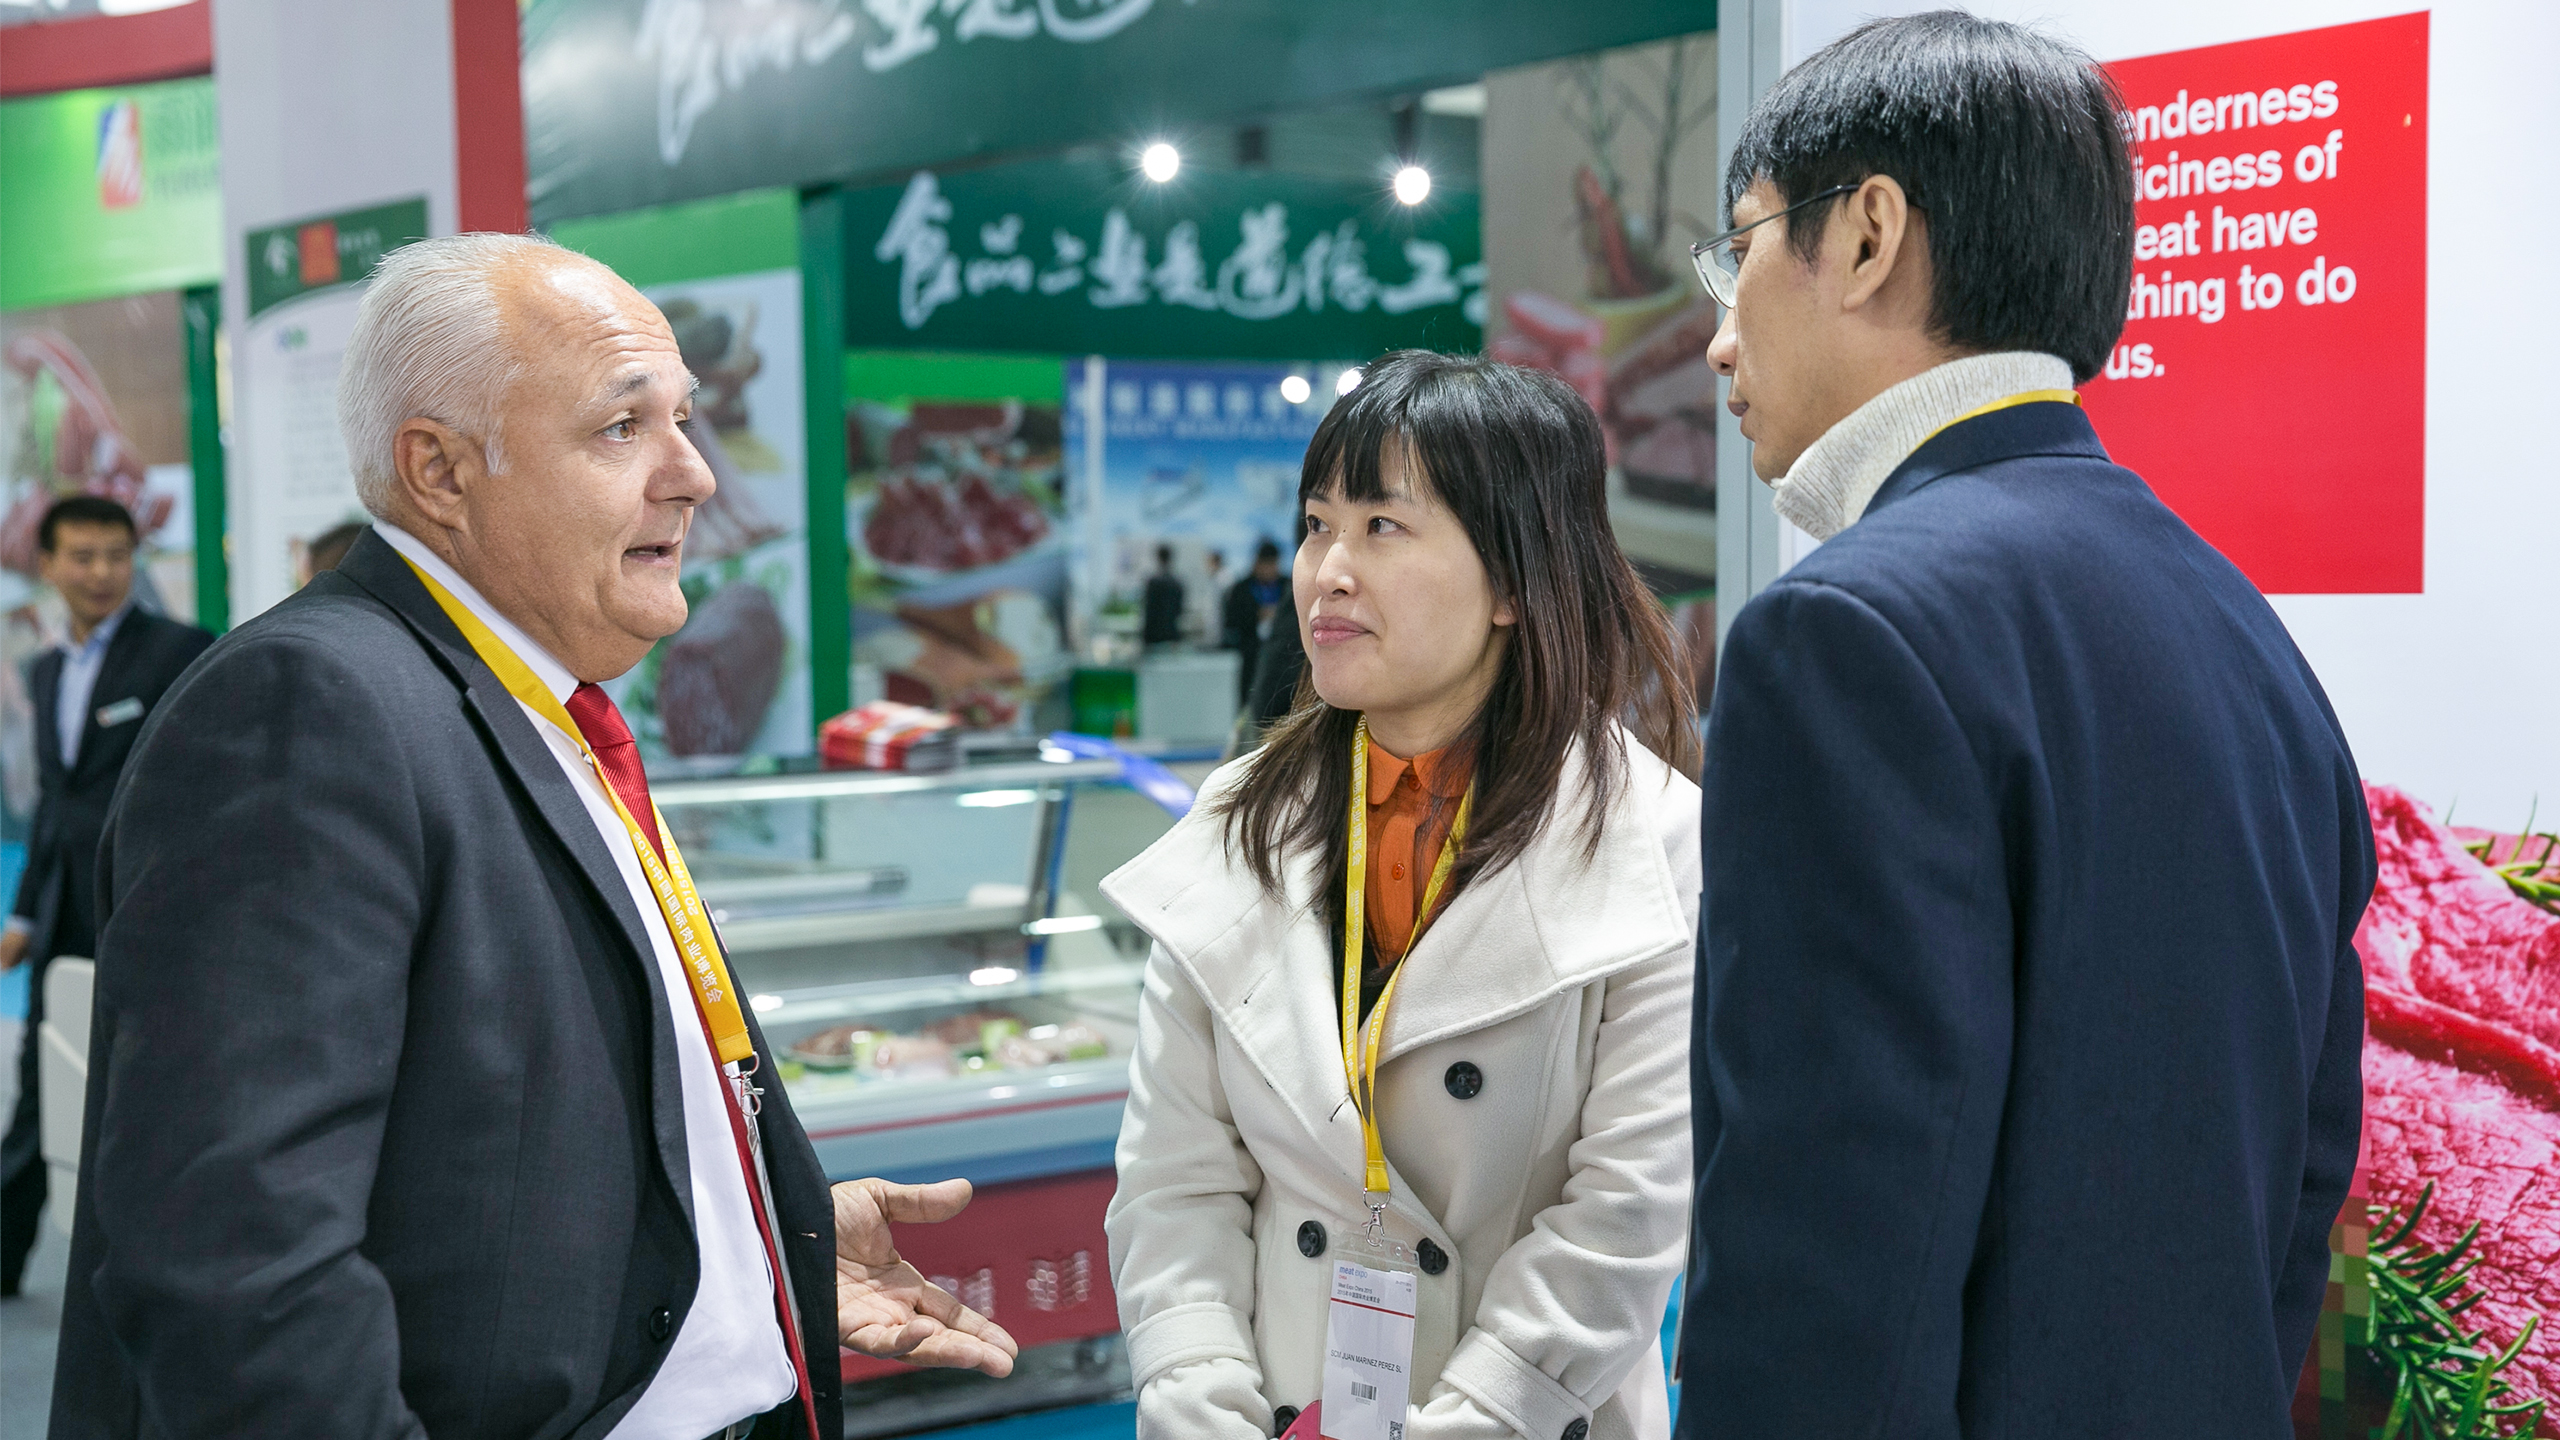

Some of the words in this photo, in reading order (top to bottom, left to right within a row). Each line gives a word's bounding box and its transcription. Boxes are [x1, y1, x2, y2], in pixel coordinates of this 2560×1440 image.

[2294, 129, 2343, 182] of
[2212, 205, 2319, 253] have
[2237, 264, 2284, 311] to
[2295, 255, 2357, 306] do
[2105, 343, 2166, 380] us.
[632, 831, 724, 1005] 2015中国国际肉业博览会
[1339, 1266, 1355, 1276] meat
[1342, 1352, 1355, 1362] JUAN
[1378, 1360, 1396, 1372] PEREZ
